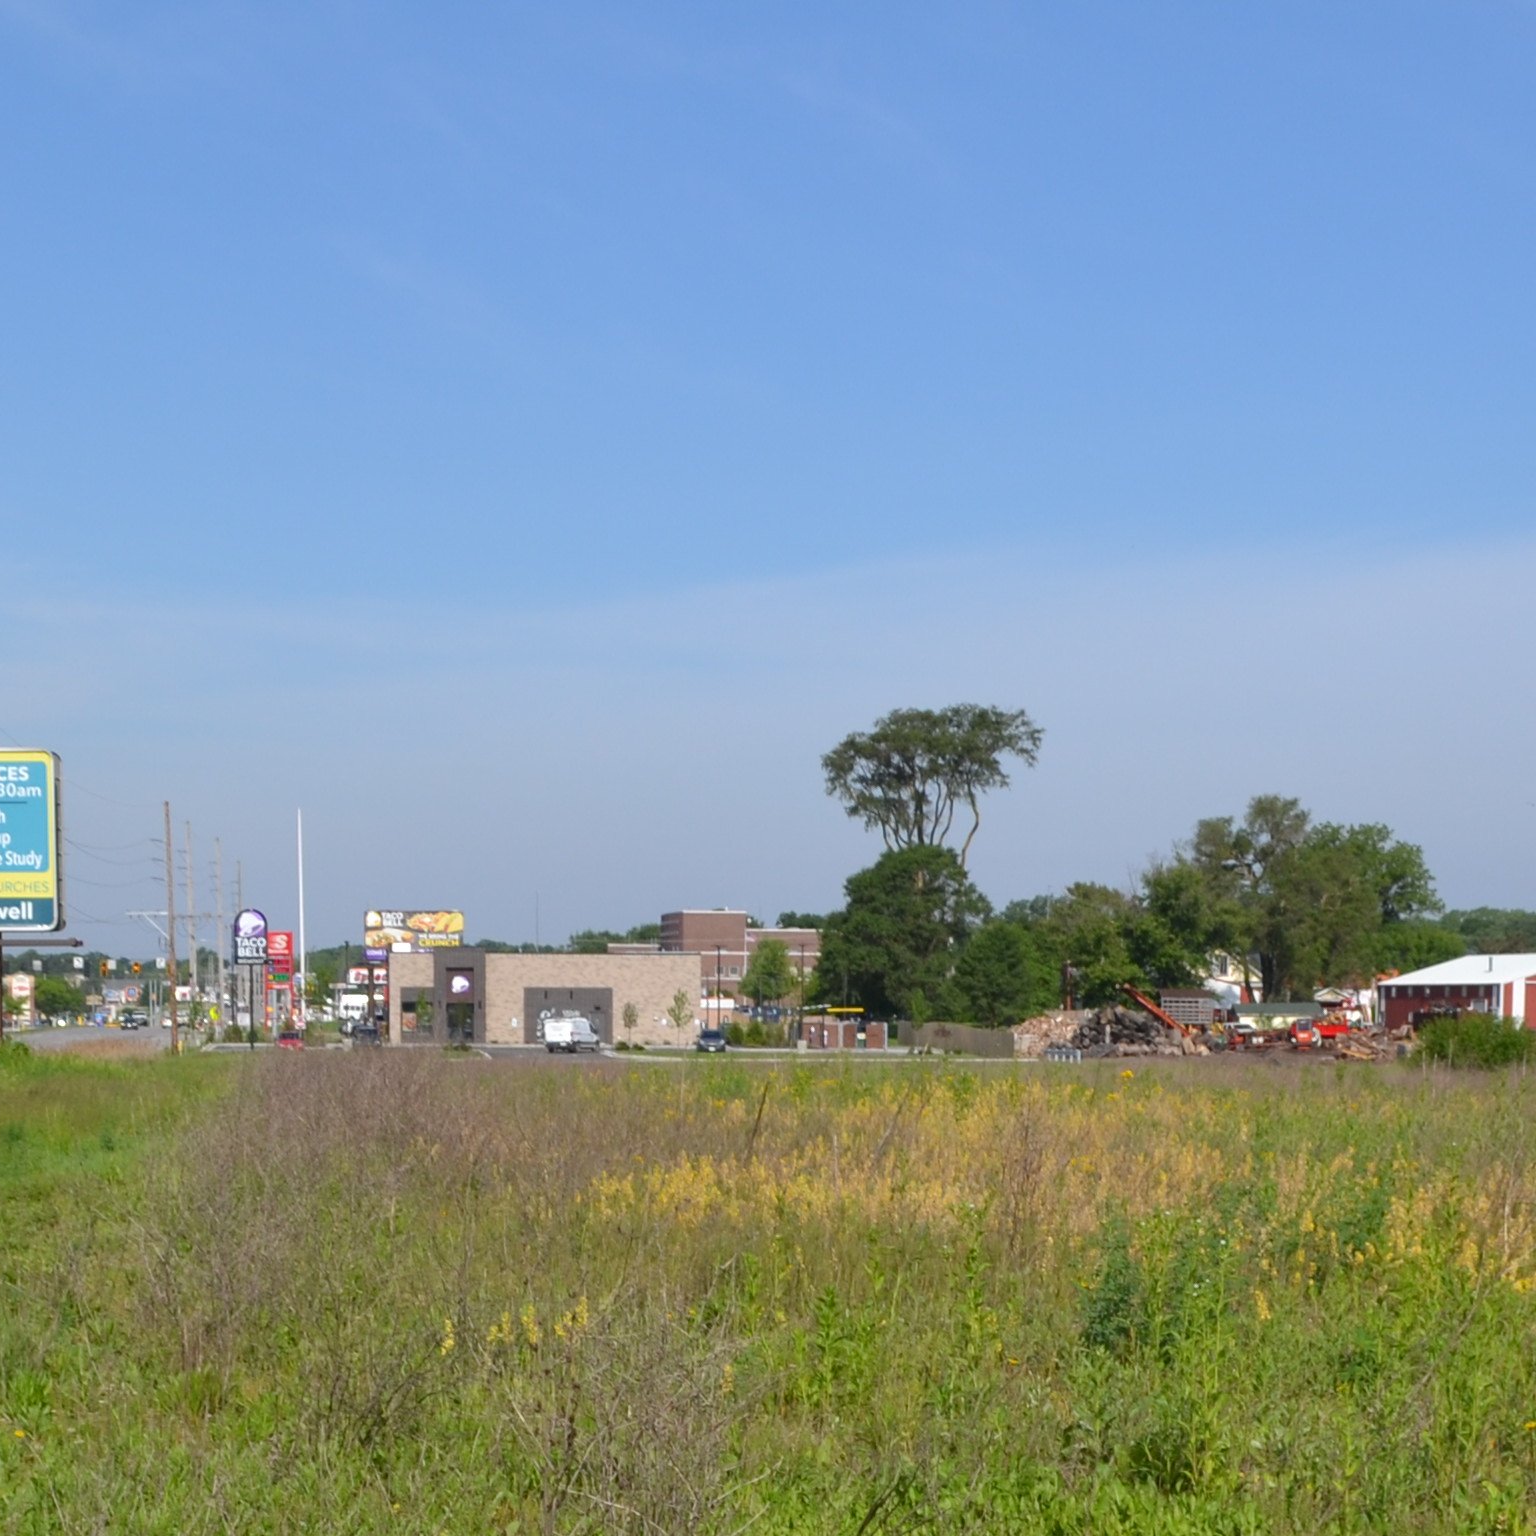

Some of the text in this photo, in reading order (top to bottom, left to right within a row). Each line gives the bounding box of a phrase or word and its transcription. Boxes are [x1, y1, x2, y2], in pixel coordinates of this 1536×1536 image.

[5, 850, 43, 869] Study
[235, 937, 266, 948] TACO
[237, 947, 266, 957] BELL
